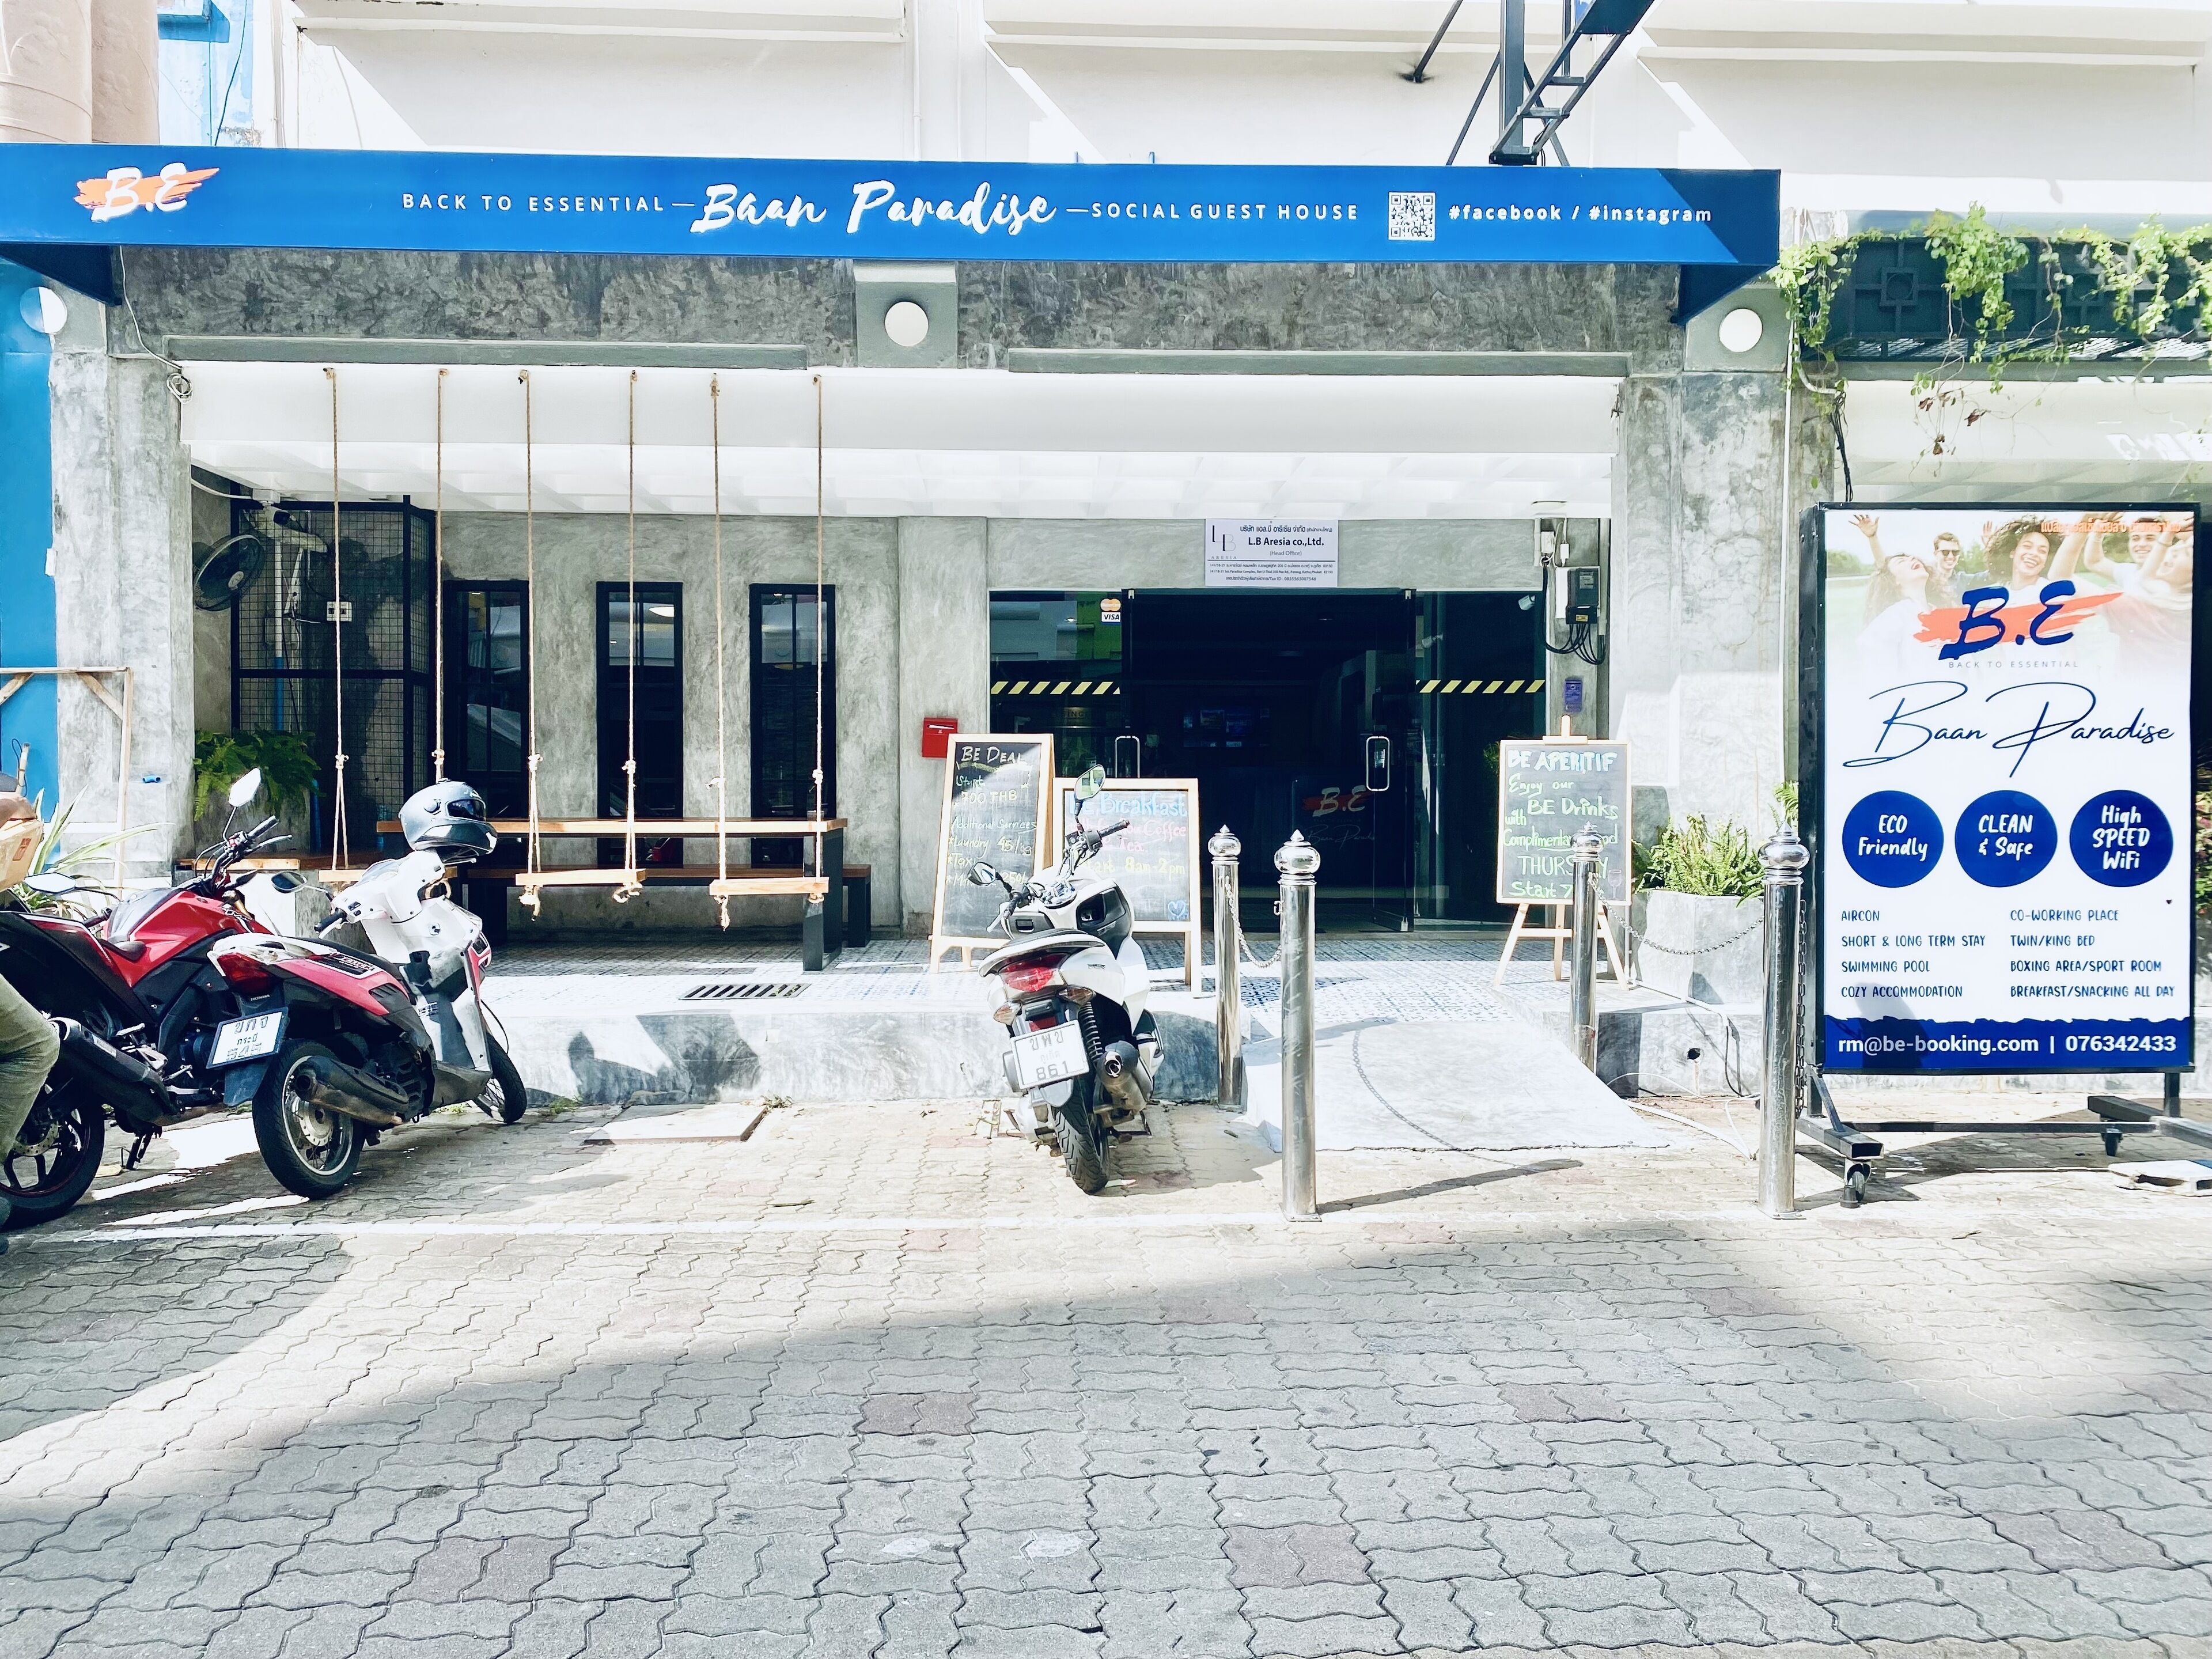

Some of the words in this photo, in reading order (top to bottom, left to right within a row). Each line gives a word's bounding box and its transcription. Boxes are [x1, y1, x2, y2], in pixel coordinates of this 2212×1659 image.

[403, 193, 467, 210] BACK
[482, 194, 513, 211] TO
[529, 195, 665, 212] ESSENTIAL
[691, 183, 827, 233] Baan
[845, 181, 1056, 235] Paradise
[1092, 202, 1180, 219] SOCIAL
[1190, 203, 1266, 220] GUEST
[1278, 204, 1358, 221] HOUSE
[1448, 204, 1562, 221] #facebook
[1588, 204, 1712, 225] #instagram
[1248, 537, 1262, 546] L.B
[1264, 537, 1290, 546] Aresia
[1293, 537, 1324, 547] co.,Ltd.
[1949, 661, 1980, 669] BACK
[1843, 681, 1987, 767] Baan
[1986, 682, 2175, 778] Paradise
[961, 746, 981, 762] BE
[987, 746, 1028, 764] DEAL
[1508, 750, 1531, 768] BE
[1533, 751, 1618, 772] APERITIF
[990, 789, 1017, 801] THB
[1508, 772, 1543, 798] Enjoy
[1551, 780, 1575, 790] our
[1100, 791, 1187, 817] Breakfast
[1527, 798, 1555, 816] BE
[1562, 796, 1619, 820] Drinks
[951, 816, 994, 831] Additional
[1505, 808, 1527, 826] with
[1878, 814, 1908, 834] ECO
[1978, 814, 2033, 834] CLEAN
[2101, 805, 2142, 830] High
[1143, 819, 1187, 842] Coffee
[2092, 827, 2150, 849] SPEED
[1858, 837, 1928, 862] Friendly
[1979, 841, 1987, 856] &
[1995, 838, 2033, 861] Safe
[1517, 855, 1609, 879] THURSY
[2103, 850, 2140, 870] WiFi
[1509, 880, 1557, 898] Start
[1841, 910, 1880, 922] AIRCON
[2010, 910, 2081, 922] CO-WORKING
[2088, 910, 2119, 922] PLACE
[1841, 935, 1876, 948] SHORT
[1882, 935, 1890, 948] &
[1895, 935, 1922, 948] LONG
[1929, 935, 1955, 948] TERM
[1961, 935, 1986, 948] STAY
[2010, 934, 2071, 948] TWIN/KING
[2078, 934, 2095, 946] BED
[1841, 961, 1897, 972] SWIMMING
[1904, 961, 1930, 972] POOL
[2010, 960, 2050, 972] BOXING
[2055, 960, 2124, 972] AREA/SPORT
[2131, 960, 2162, 972] ROOM
[1841, 986, 1867, 998] COZY
[1873, 986, 1963, 998] ACCOMMODATION
[2010, 985, 2129, 998] BREAKFAST/SNACKING
[2134, 985, 2152, 997] ALL
[2157, 985, 2176, 998] DAY
[1839, 1035, 2039, 1056] rm@be-booking.com
[2066, 1035, 2177, 1052] 076342433
[1036, 1060, 1069, 1081] 861
